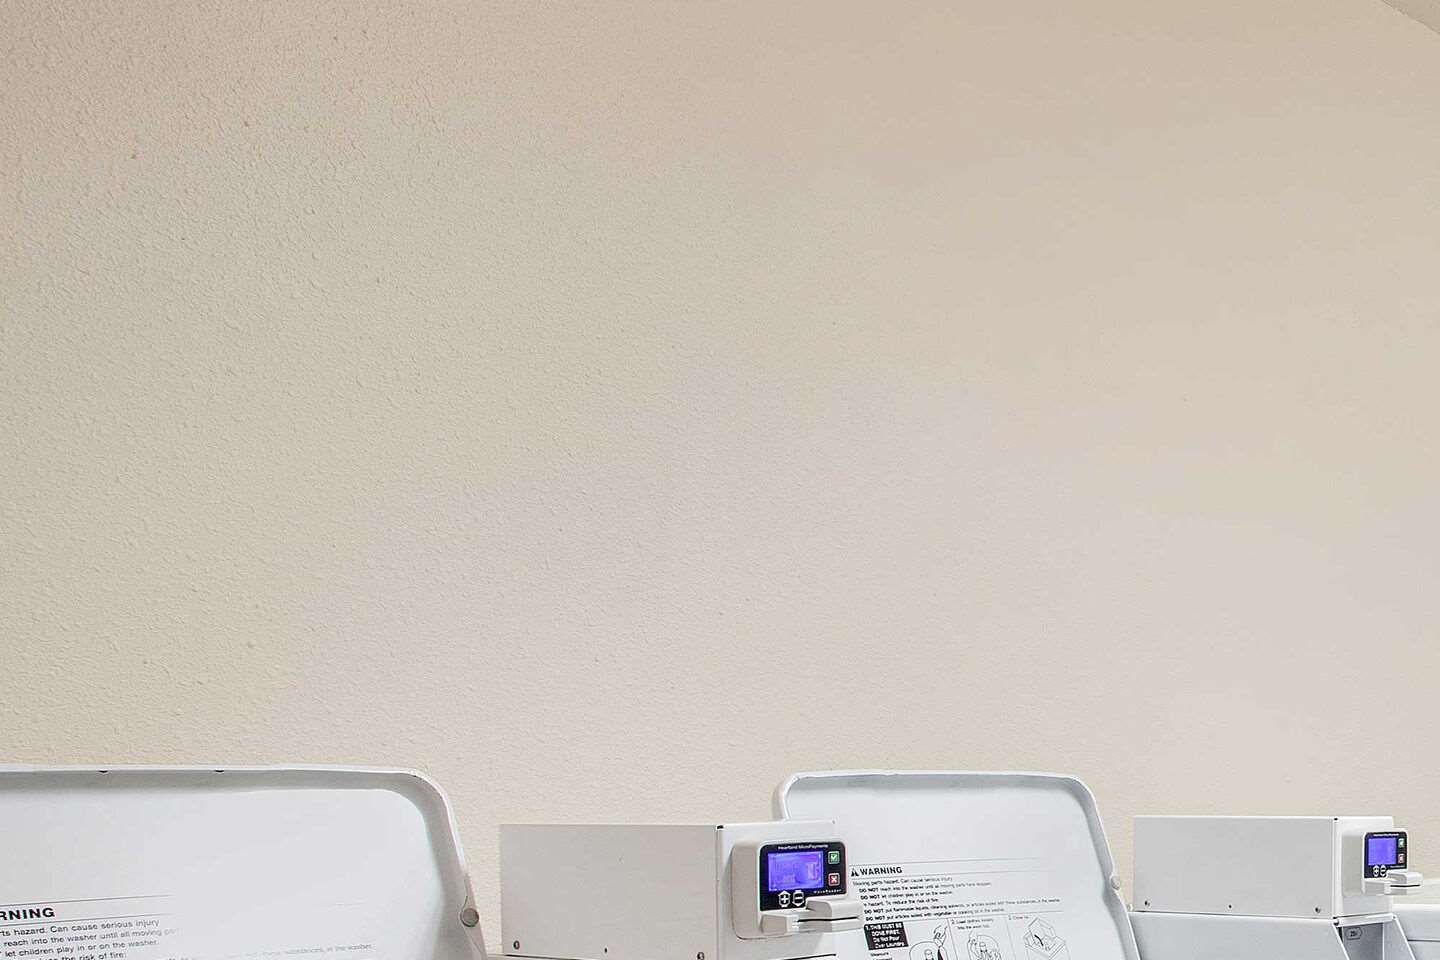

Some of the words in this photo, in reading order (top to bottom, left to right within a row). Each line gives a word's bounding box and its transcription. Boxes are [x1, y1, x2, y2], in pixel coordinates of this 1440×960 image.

[860, 866, 902, 876] WARNING
[50, 925, 68, 933] Can
[72, 924, 98, 932] cause
[101, 921, 133, 929] serious
[67, 934, 97, 942] washer
[19, 948, 54, 956] children
[57, 946, 74, 954] play
